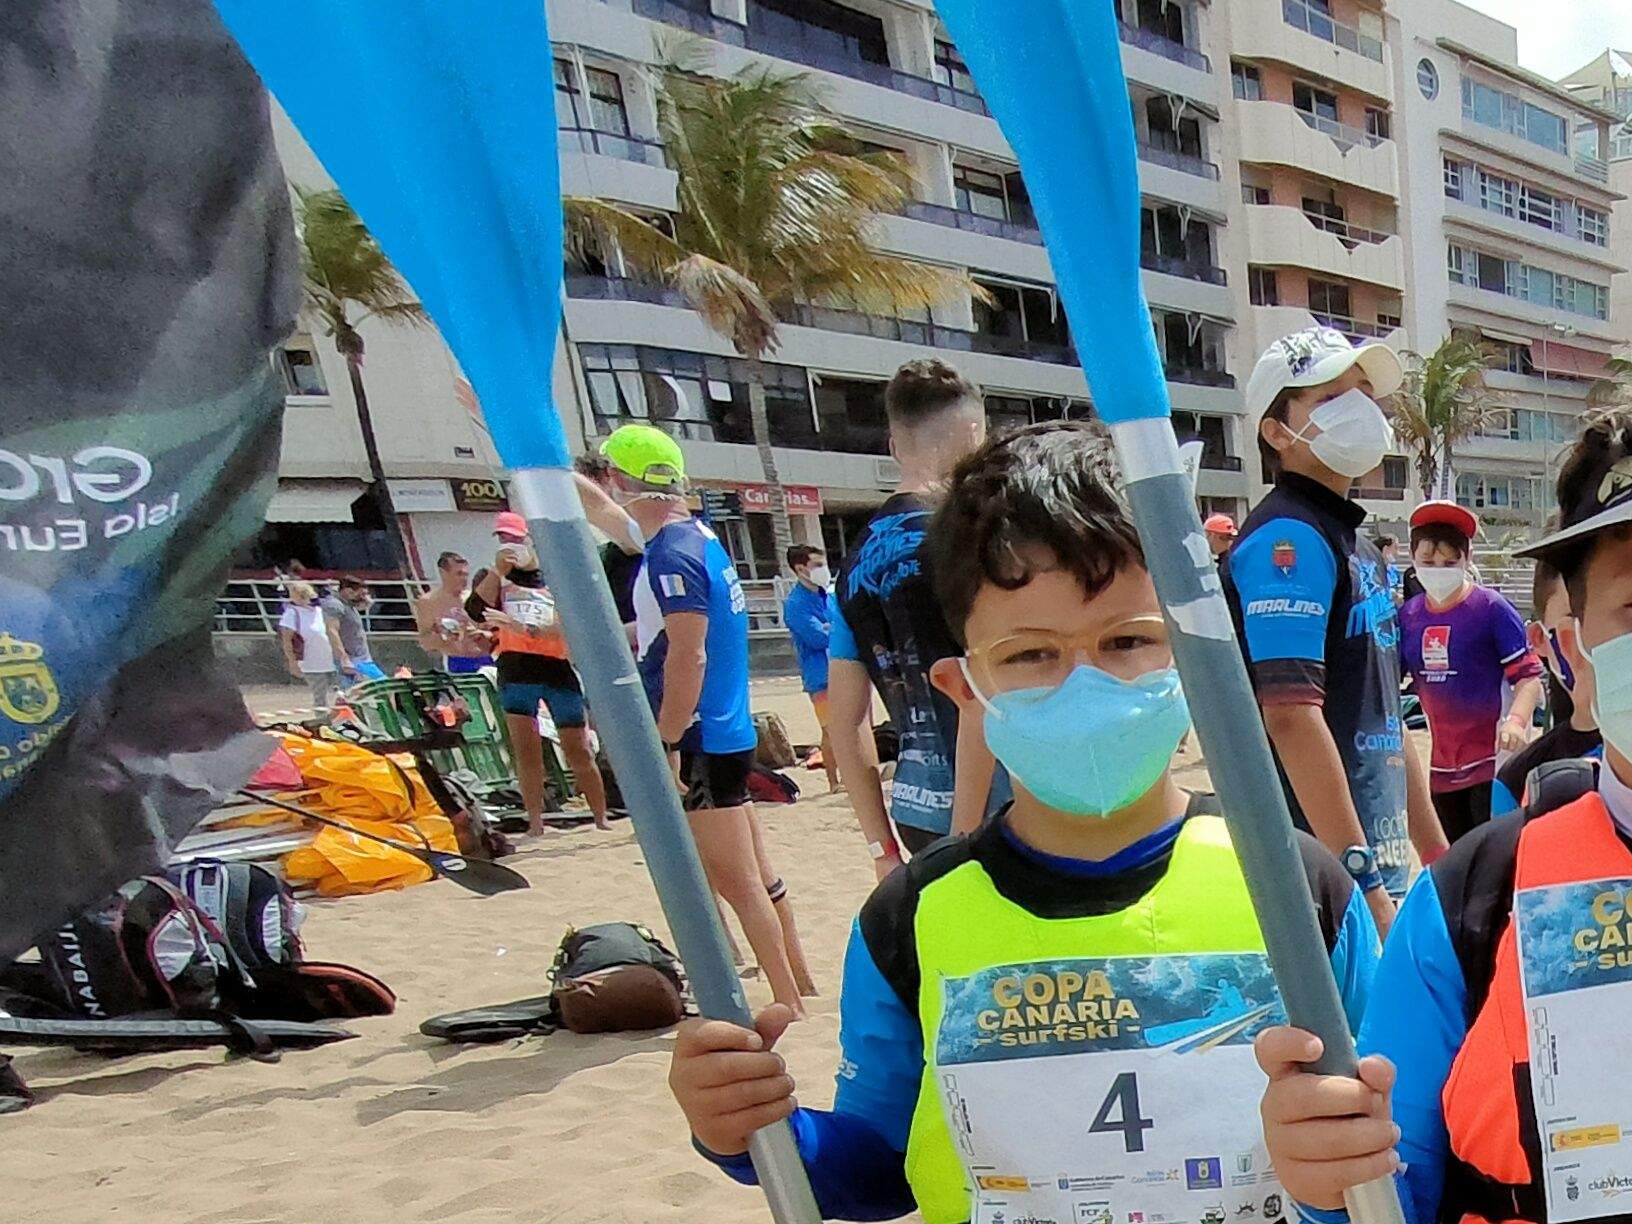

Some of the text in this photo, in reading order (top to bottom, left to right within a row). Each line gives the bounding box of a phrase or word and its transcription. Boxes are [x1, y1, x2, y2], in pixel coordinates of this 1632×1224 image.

[1246, 597, 1326, 617] MARLINES
[992, 970, 1116, 1010] COPA
[976, 999, 1141, 1031] CANARIA
[1087, 1071, 1155, 1153] 4
